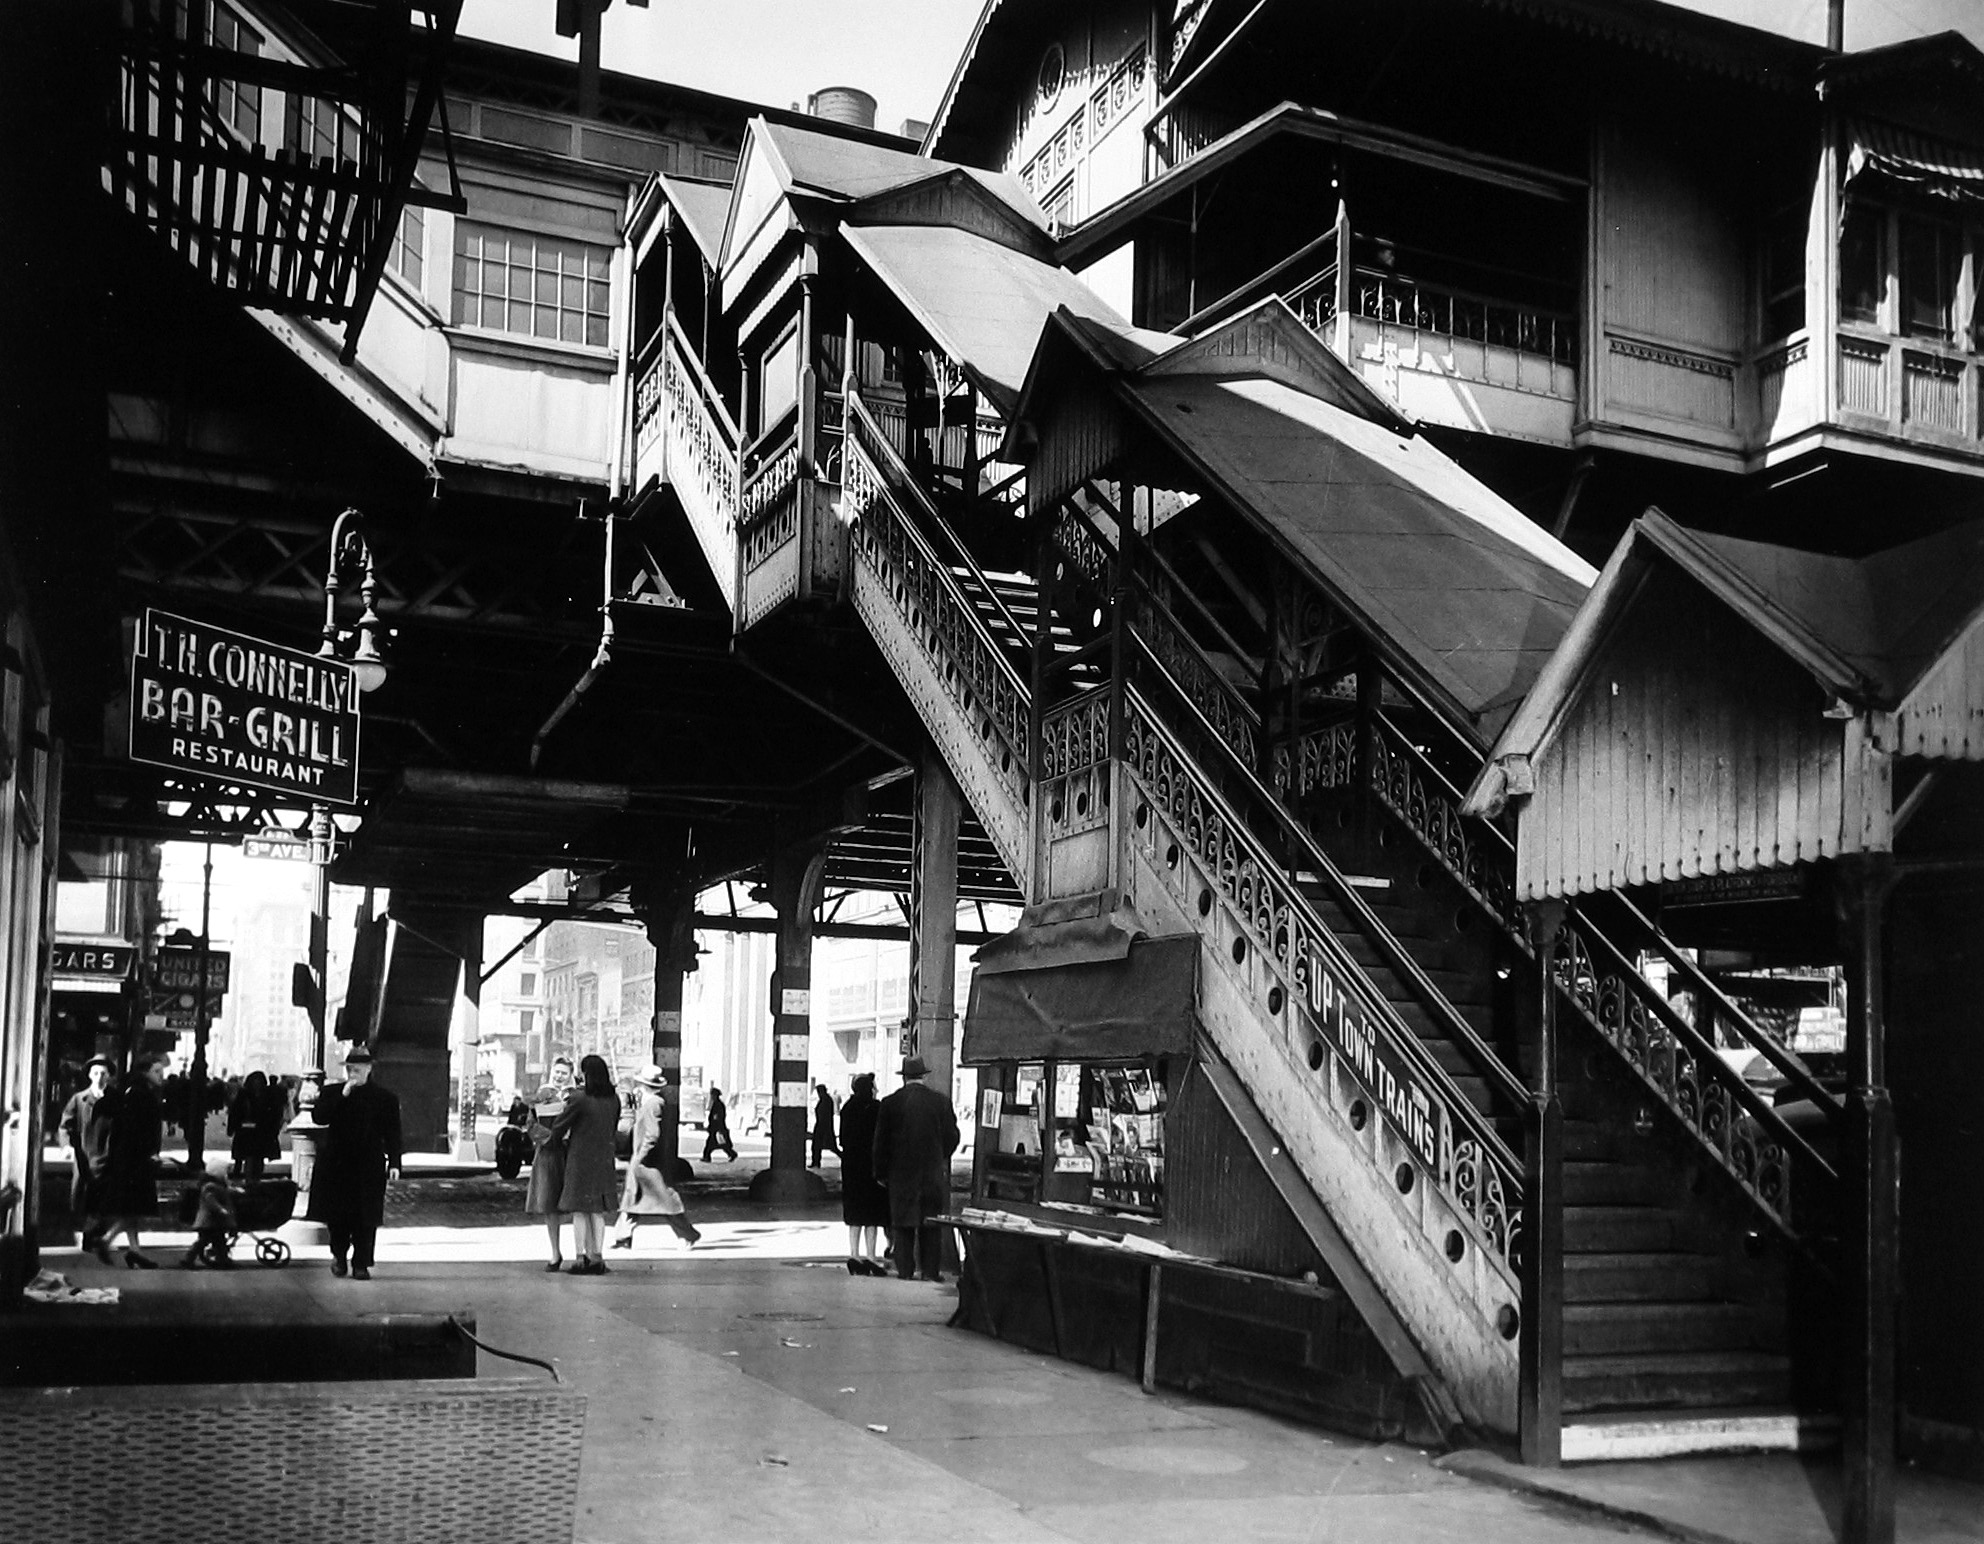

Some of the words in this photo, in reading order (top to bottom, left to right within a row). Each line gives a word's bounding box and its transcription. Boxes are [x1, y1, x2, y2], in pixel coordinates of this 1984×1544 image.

[208, 641, 348, 714] CONNELLY
[172, 737, 324, 785] RESTAURANT
[1359, 1012, 1376, 1046] TO
[1311, 957, 1333, 1024] UP
[1376, 1057, 1435, 1166] TRAINS
